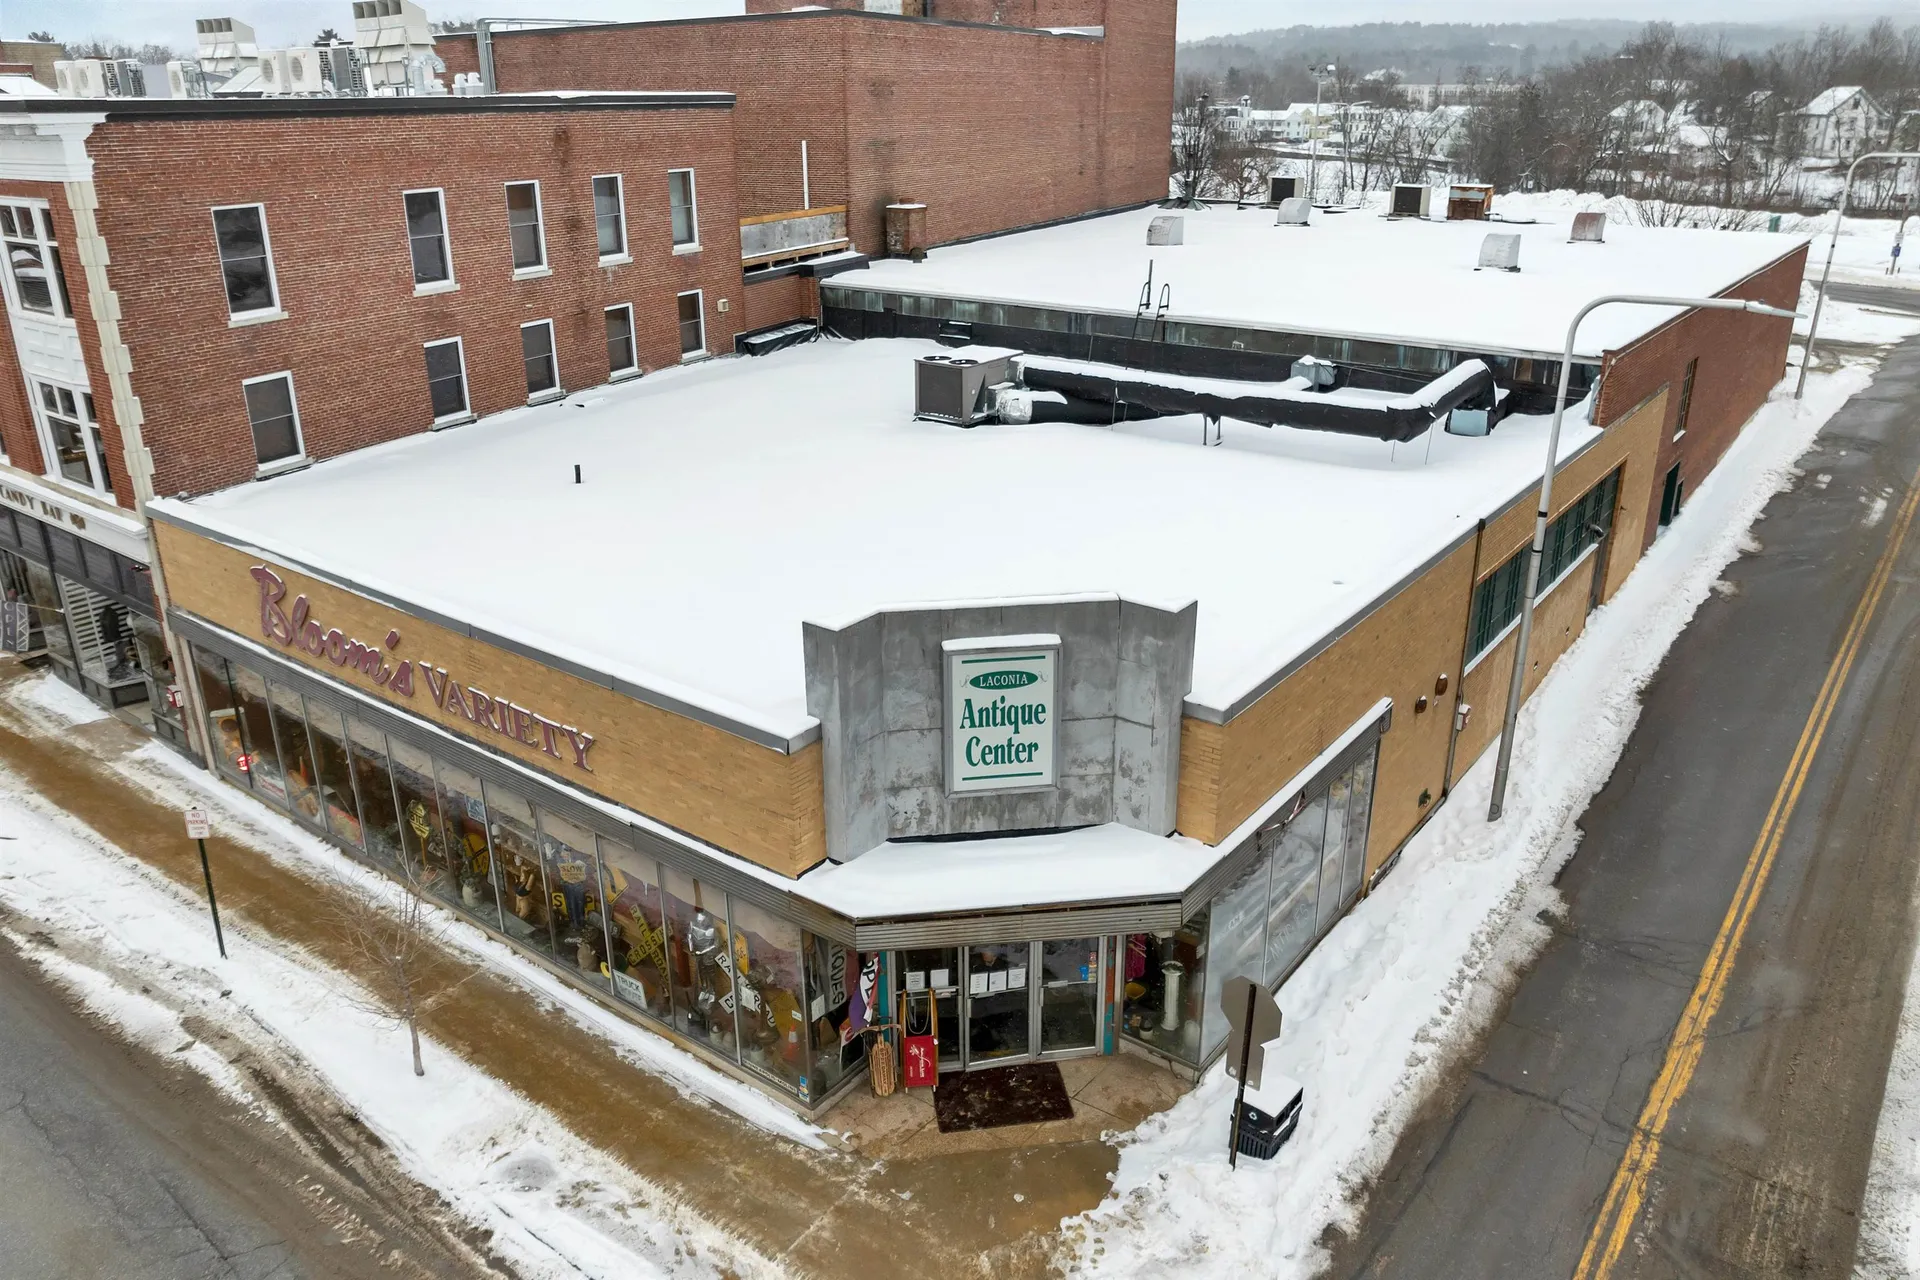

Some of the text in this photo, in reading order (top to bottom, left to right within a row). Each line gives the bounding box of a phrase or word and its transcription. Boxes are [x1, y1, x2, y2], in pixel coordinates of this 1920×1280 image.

[250, 563, 595, 772] Bloom's VARIETY
[979, 674, 1028, 687] LACONIA
[959, 695, 1047, 735] Antique
[965, 735, 1039, 767] Center
[560, 864, 585, 874] SLOW
